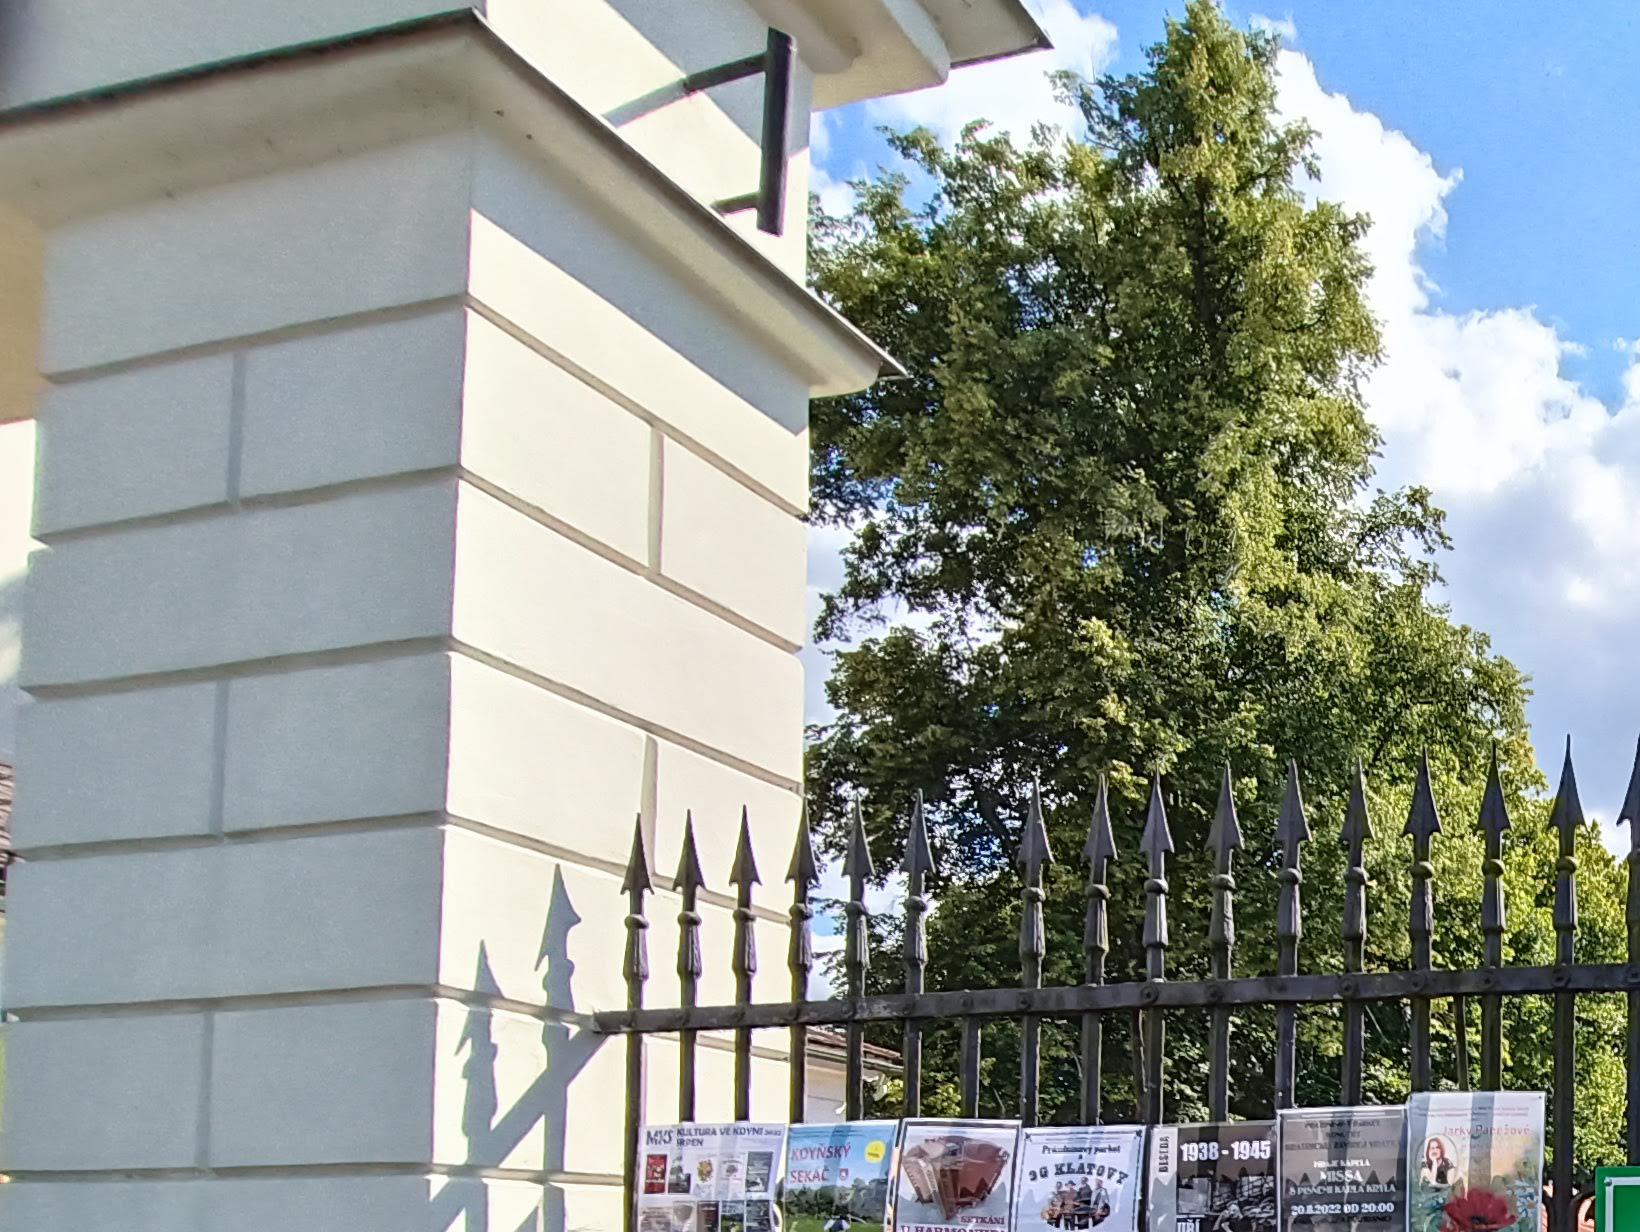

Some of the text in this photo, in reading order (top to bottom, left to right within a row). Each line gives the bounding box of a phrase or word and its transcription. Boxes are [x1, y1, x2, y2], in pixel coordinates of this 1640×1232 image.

[676, 1127, 717, 1137] KULTURA
[791, 1142, 851, 1160] KDYŇSKÝ
[1158, 1136, 1170, 1173] BESEDA
[1180, 1142, 1219, 1161] 1938
[1230, 1140, 1271, 1160] 1945
[790, 1165, 830, 1183] SEKÁČ
[1054, 1162, 1129, 1184] KLATOVY
[1320, 1169, 1363, 1183] MISSA
